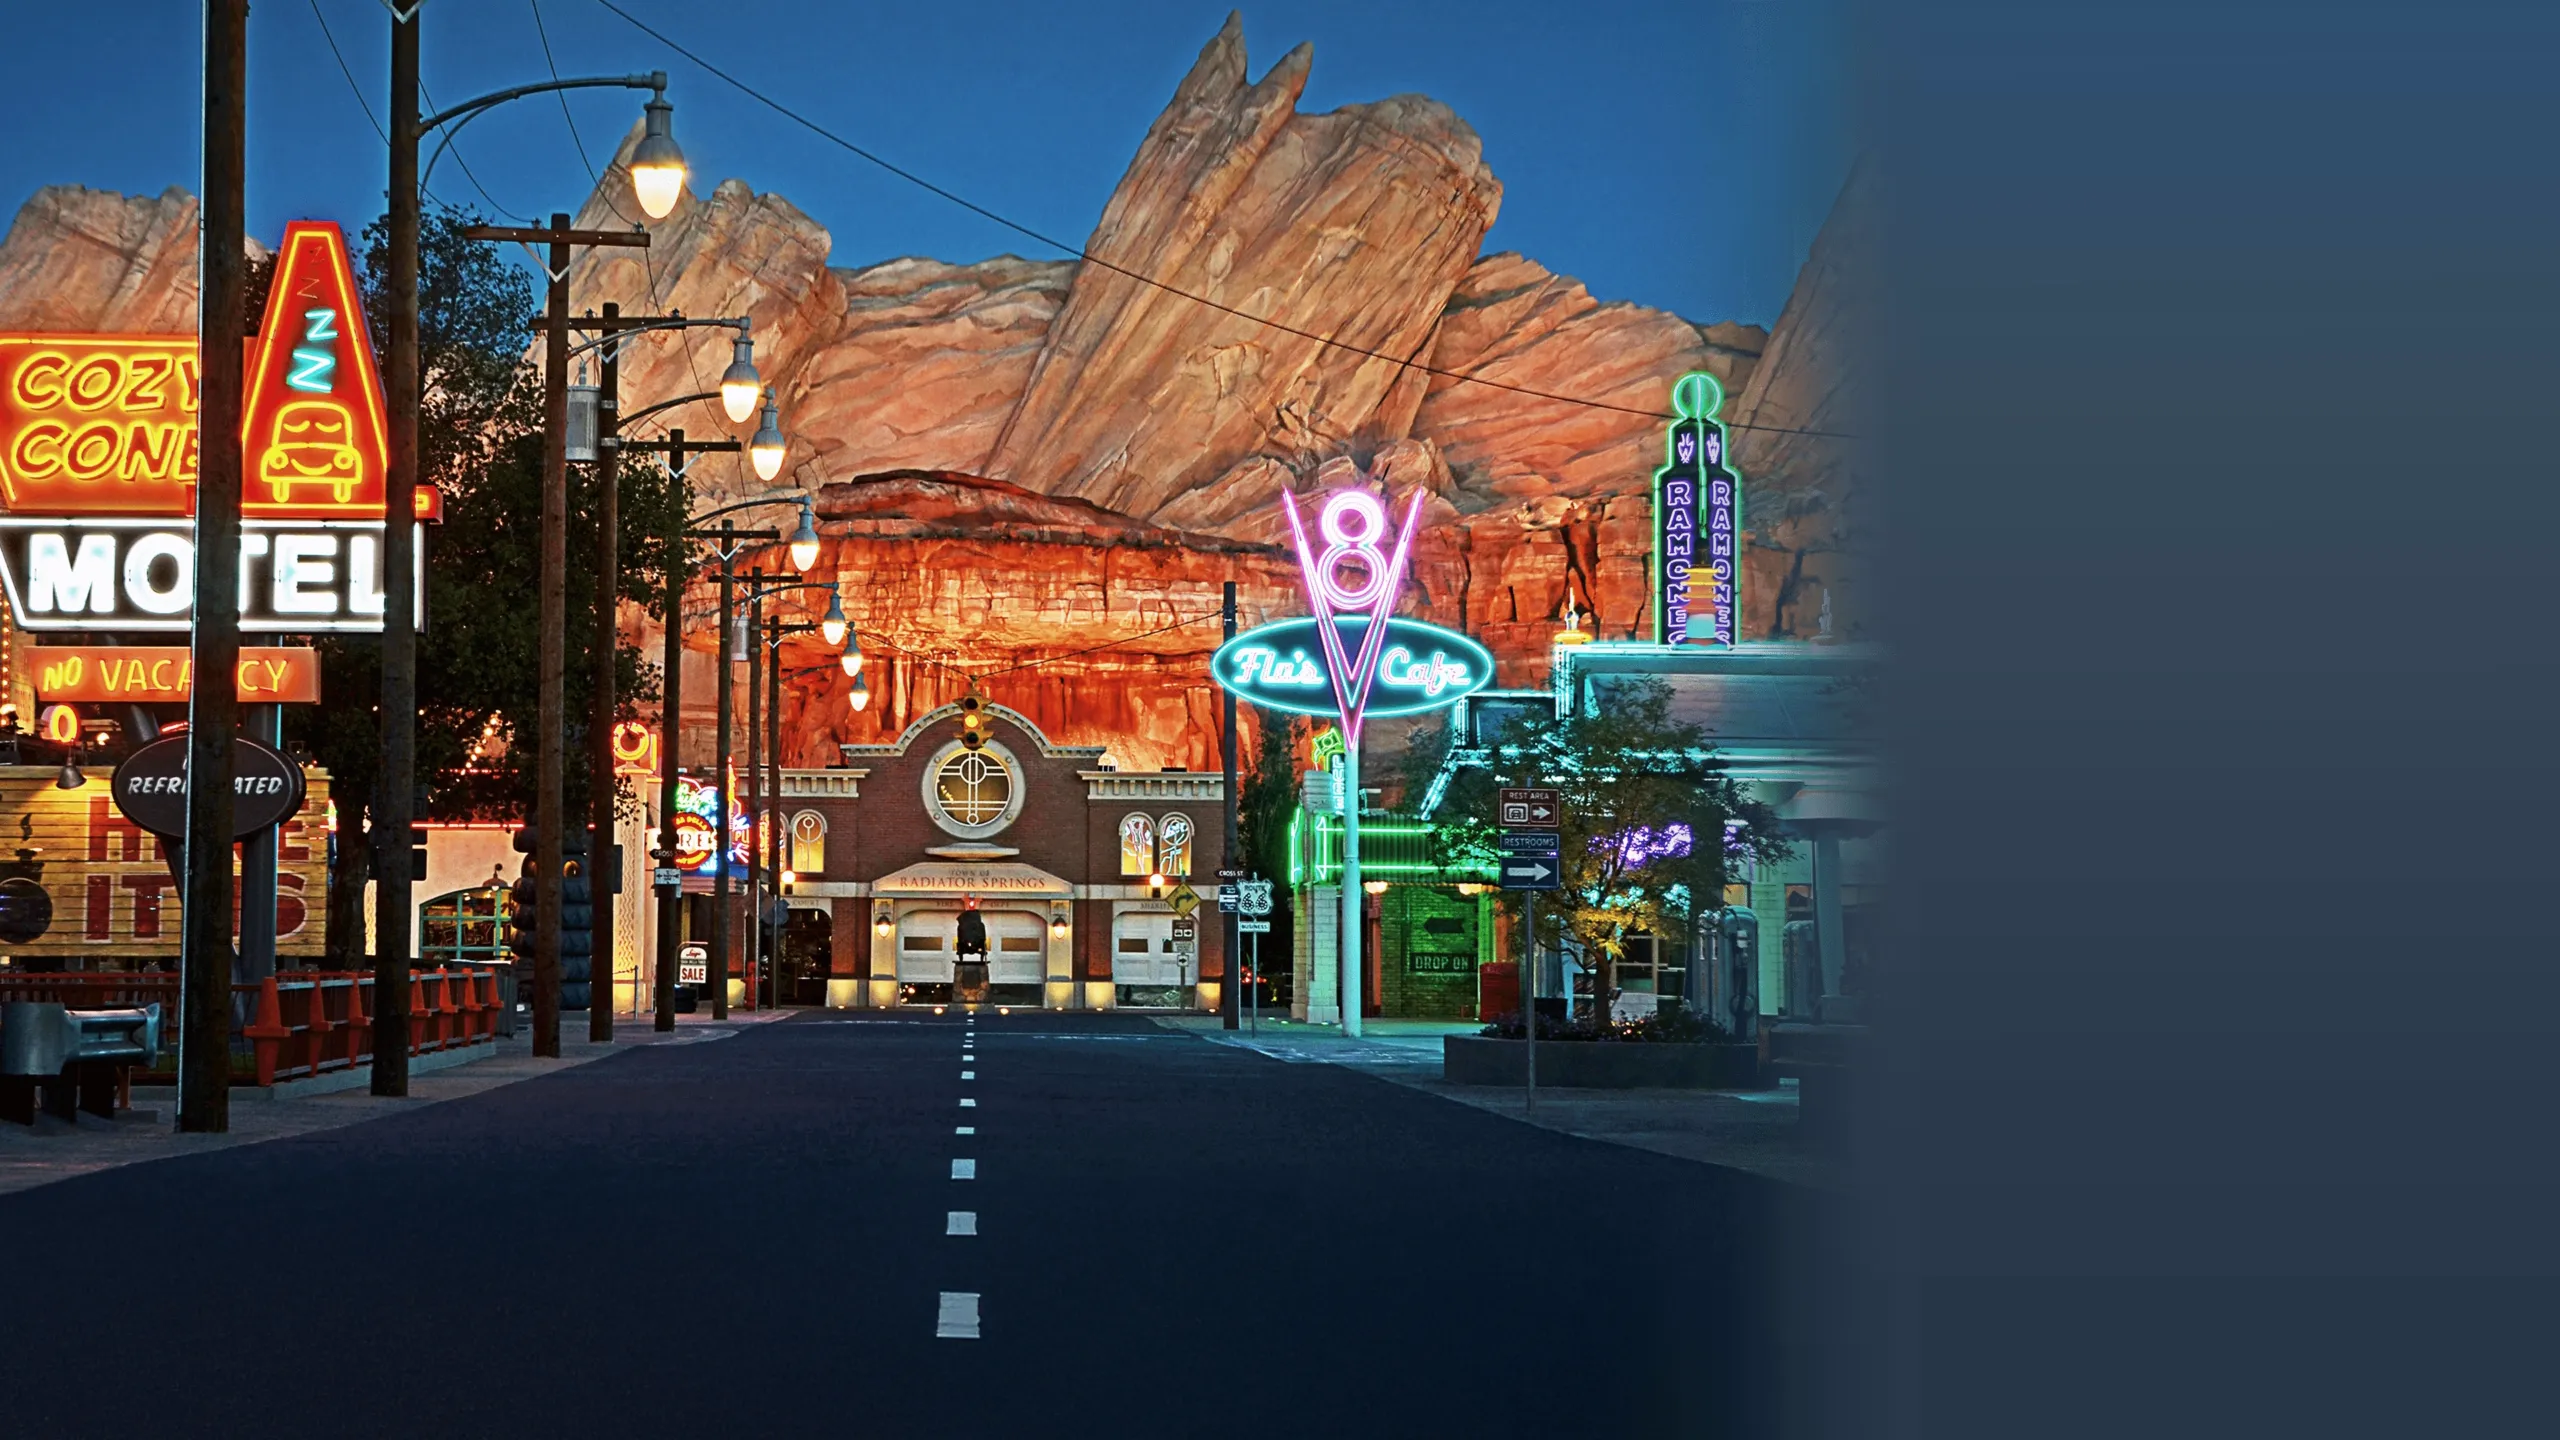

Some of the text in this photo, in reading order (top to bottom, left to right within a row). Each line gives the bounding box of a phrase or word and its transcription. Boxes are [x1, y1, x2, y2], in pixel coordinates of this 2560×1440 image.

[43, 656, 289, 693] NO VACACY
[1380, 647, 1471, 695] Cafe
[1509, 792, 1549, 800] REST AREA
[1504, 838, 1554, 847] RESTROOMS
[900, 877, 1045, 888] RADIATOR SPRINGS
[1242, 893, 1268, 910] 66
[1415, 956, 1449, 969] DROP
[1453, 956, 1468, 970] ON
[681, 967, 704, 980] SALE
